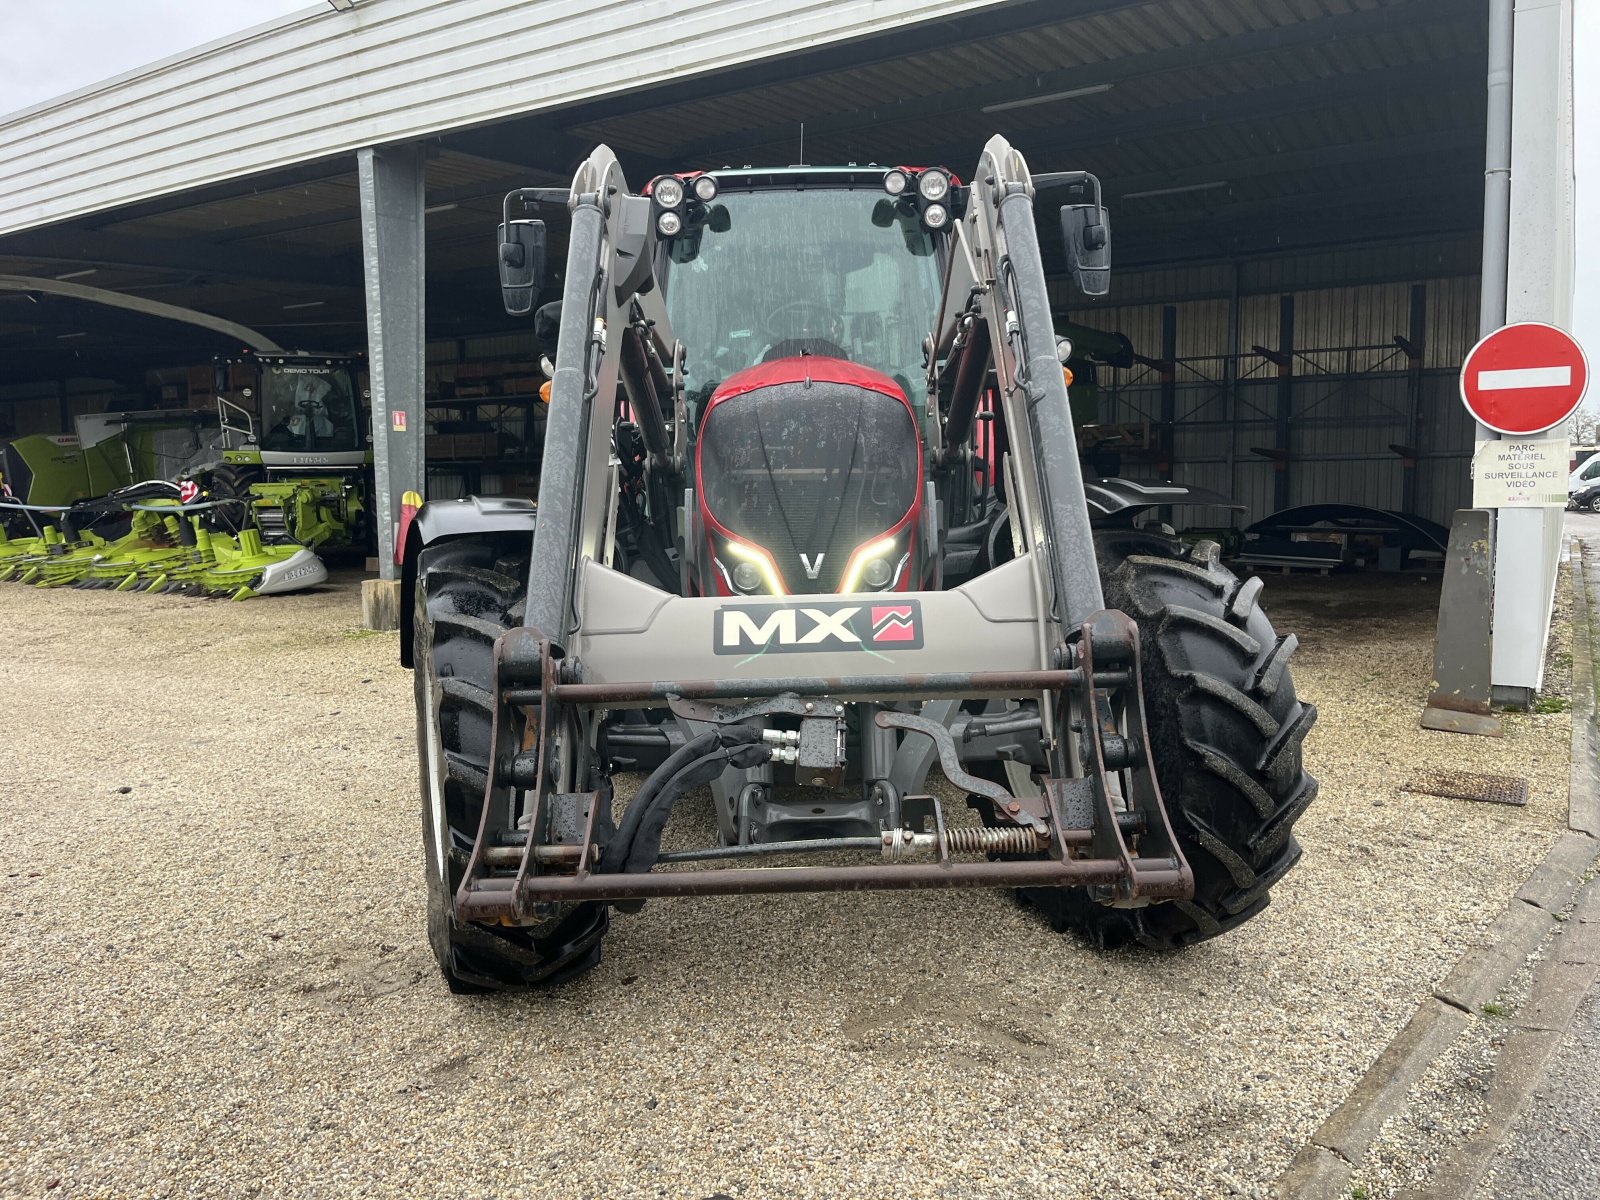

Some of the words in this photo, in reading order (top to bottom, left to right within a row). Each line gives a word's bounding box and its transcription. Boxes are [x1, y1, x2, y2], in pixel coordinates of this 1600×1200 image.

[1509, 444, 1535, 452] PARC
[1484, 471, 1559, 480] SURVEILLANCE
[722, 607, 863, 646] MX
